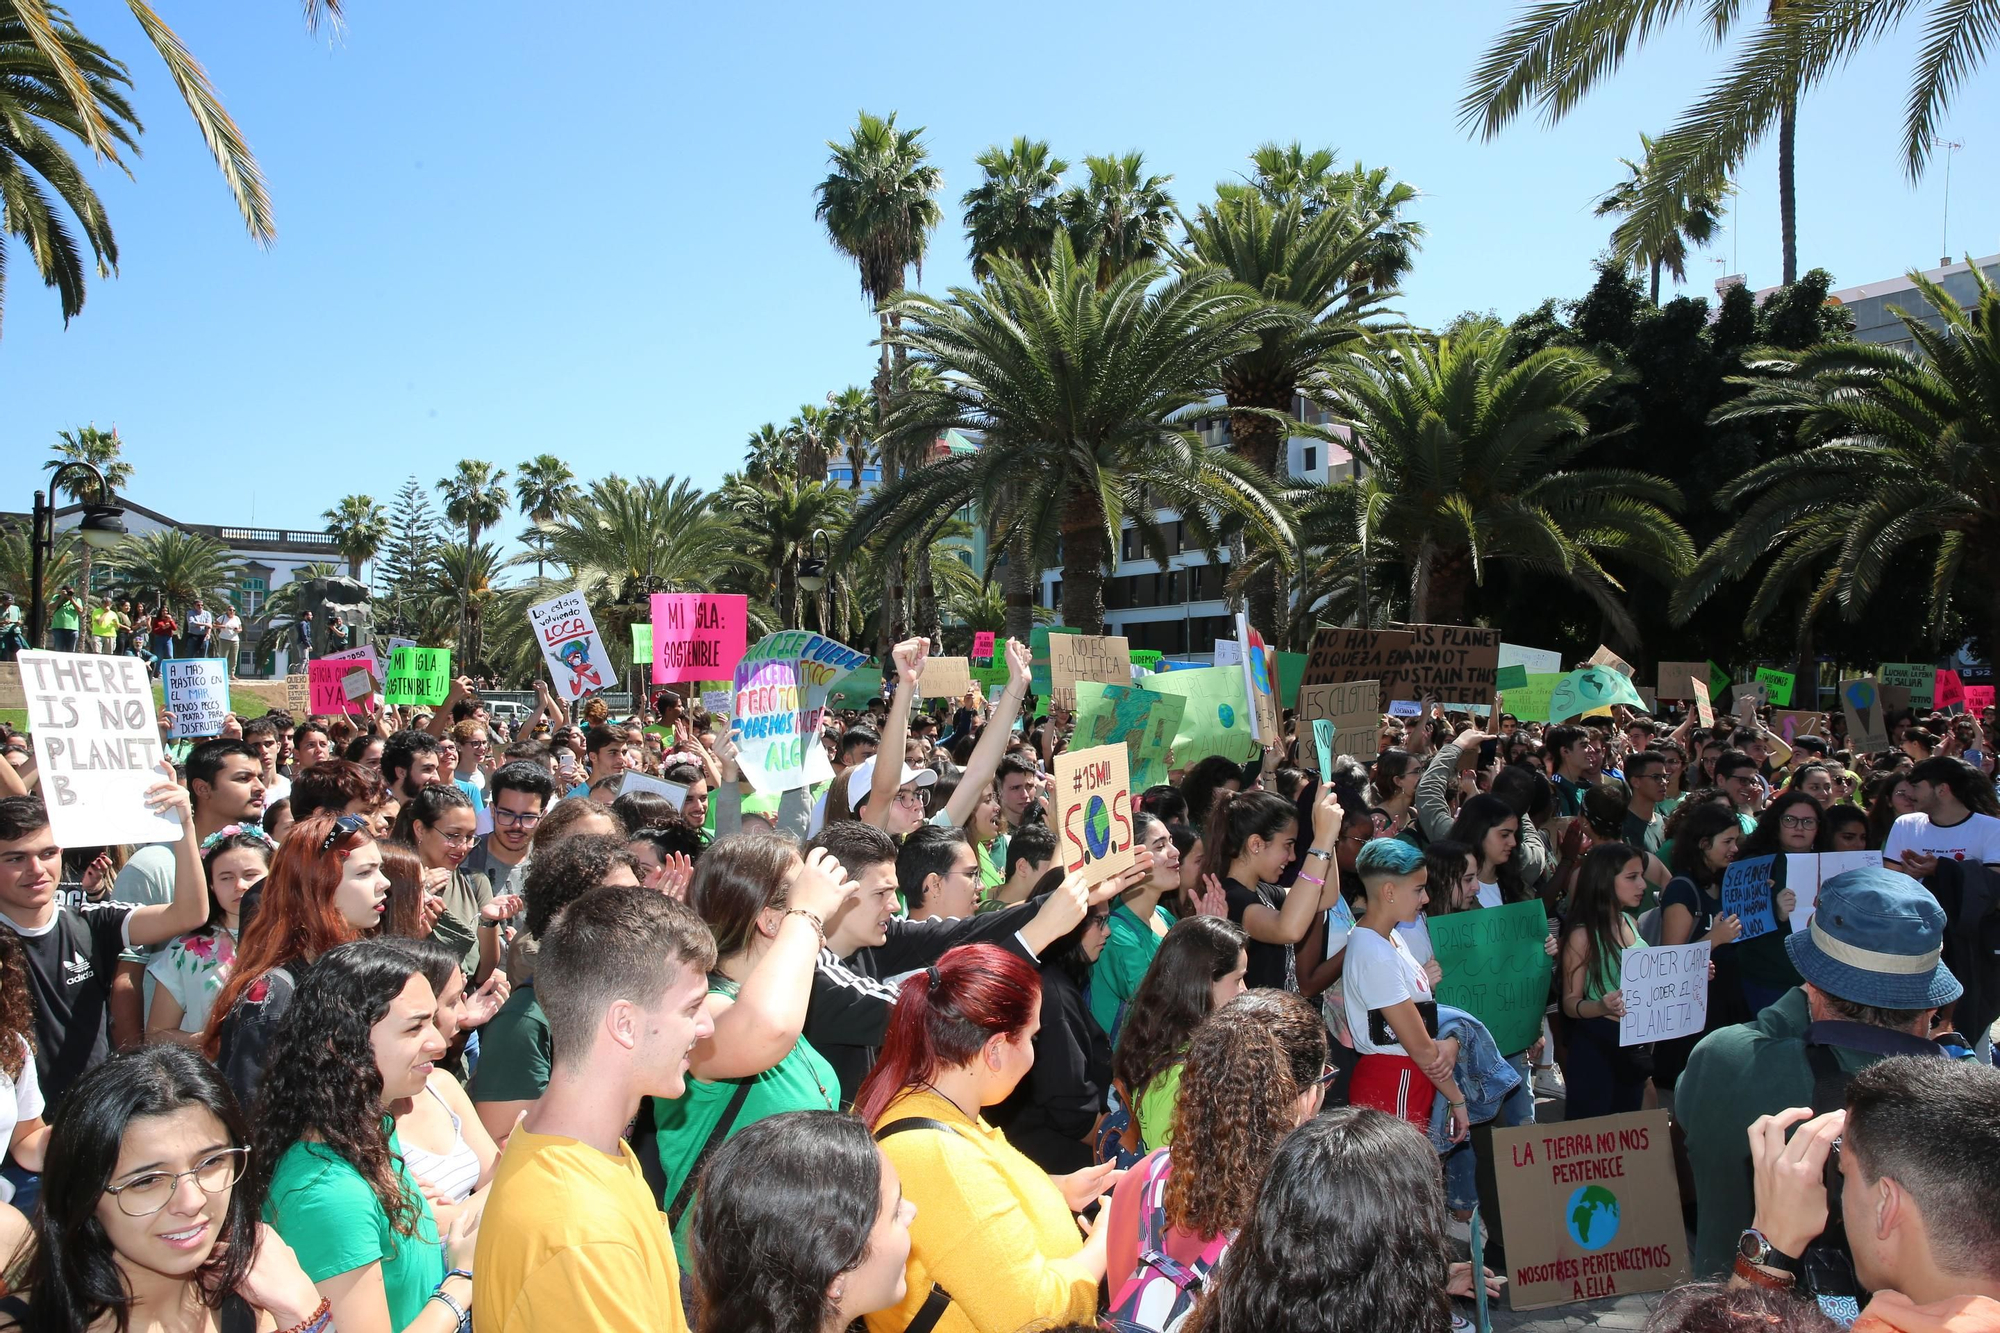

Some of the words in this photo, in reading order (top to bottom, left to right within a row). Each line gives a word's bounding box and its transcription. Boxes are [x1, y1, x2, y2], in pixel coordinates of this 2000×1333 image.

[532, 608, 547, 620] La
[551, 599, 580, 613] estáis
[539, 608, 581, 627] volviendo
[544, 618, 585, 642] LOCA
[1313, 630, 1339, 650] NO
[1344, 631, 1380, 650] HAY
[1442, 629, 1500, 648] PLANET
[664, 635, 720, 669] SOSTENIBLE
[742, 632, 807, 662] NADIE
[801, 635, 867, 671] PUEDE
[1071, 638, 1088, 657] NO
[1092, 636, 1107, 659] ES
[1305, 649, 1381, 668] RIQUEZA
[1402, 649, 1469, 668] ANNOT
[21, 657, 142, 695] THERE
[170, 665, 177, 677] A
[211, 675, 223, 685] EN
[735, 659, 800, 693] HACERLO
[799, 659, 837, 687] TODO
[1221, 671, 1242, 698] IS
[1400, 667, 1464, 687] USTAIN
[1466, 667, 1498, 687] THIS
[171, 691, 181, 701] EL
[172, 701, 199, 713] MENOS
[317, 684, 351, 707] ¡YA
[736, 684, 777, 718] PERO
[1299, 690, 1325, 722] LES
[1412, 685, 1488, 704] SYSTEM
[36, 694, 80, 730] IS
[181, 712, 205, 723] PLAYAS
[208, 709, 225, 720] PARA
[731, 711, 794, 742] PODEMOS
[44, 736, 156, 771] PLANET
[1073, 760, 1112, 794] #15M!!
[1437, 922, 1478, 953] RAISE
[1481, 915, 1508, 945] YOUR
[1511, 913, 1542, 940] VOICE
[1624, 950, 1678, 983] COMER
[1684, 947, 1710, 973] CARNE
[1437, 982, 1487, 1015] NOT
[1496, 981, 1516, 1012] SEA
[1624, 988, 1641, 1010] ES
[1646, 982, 1676, 1008] JODER
[1679, 980, 1691, 997] EL
[1624, 1002, 1693, 1040] PLANETA
[1512, 1142, 1535, 1168] LA
[1542, 1133, 1594, 1162] TIERRA
[1597, 1131, 1616, 1154] NO
[1619, 1127, 1649, 1151] NOS
[1552, 1155, 1626, 1185] PERTENECE
[1582, 1243, 1672, 1277] PERTENECEMOS
[1573, 1280, 1585, 1300] A
[1586, 1274, 1617, 1299] ELLA
